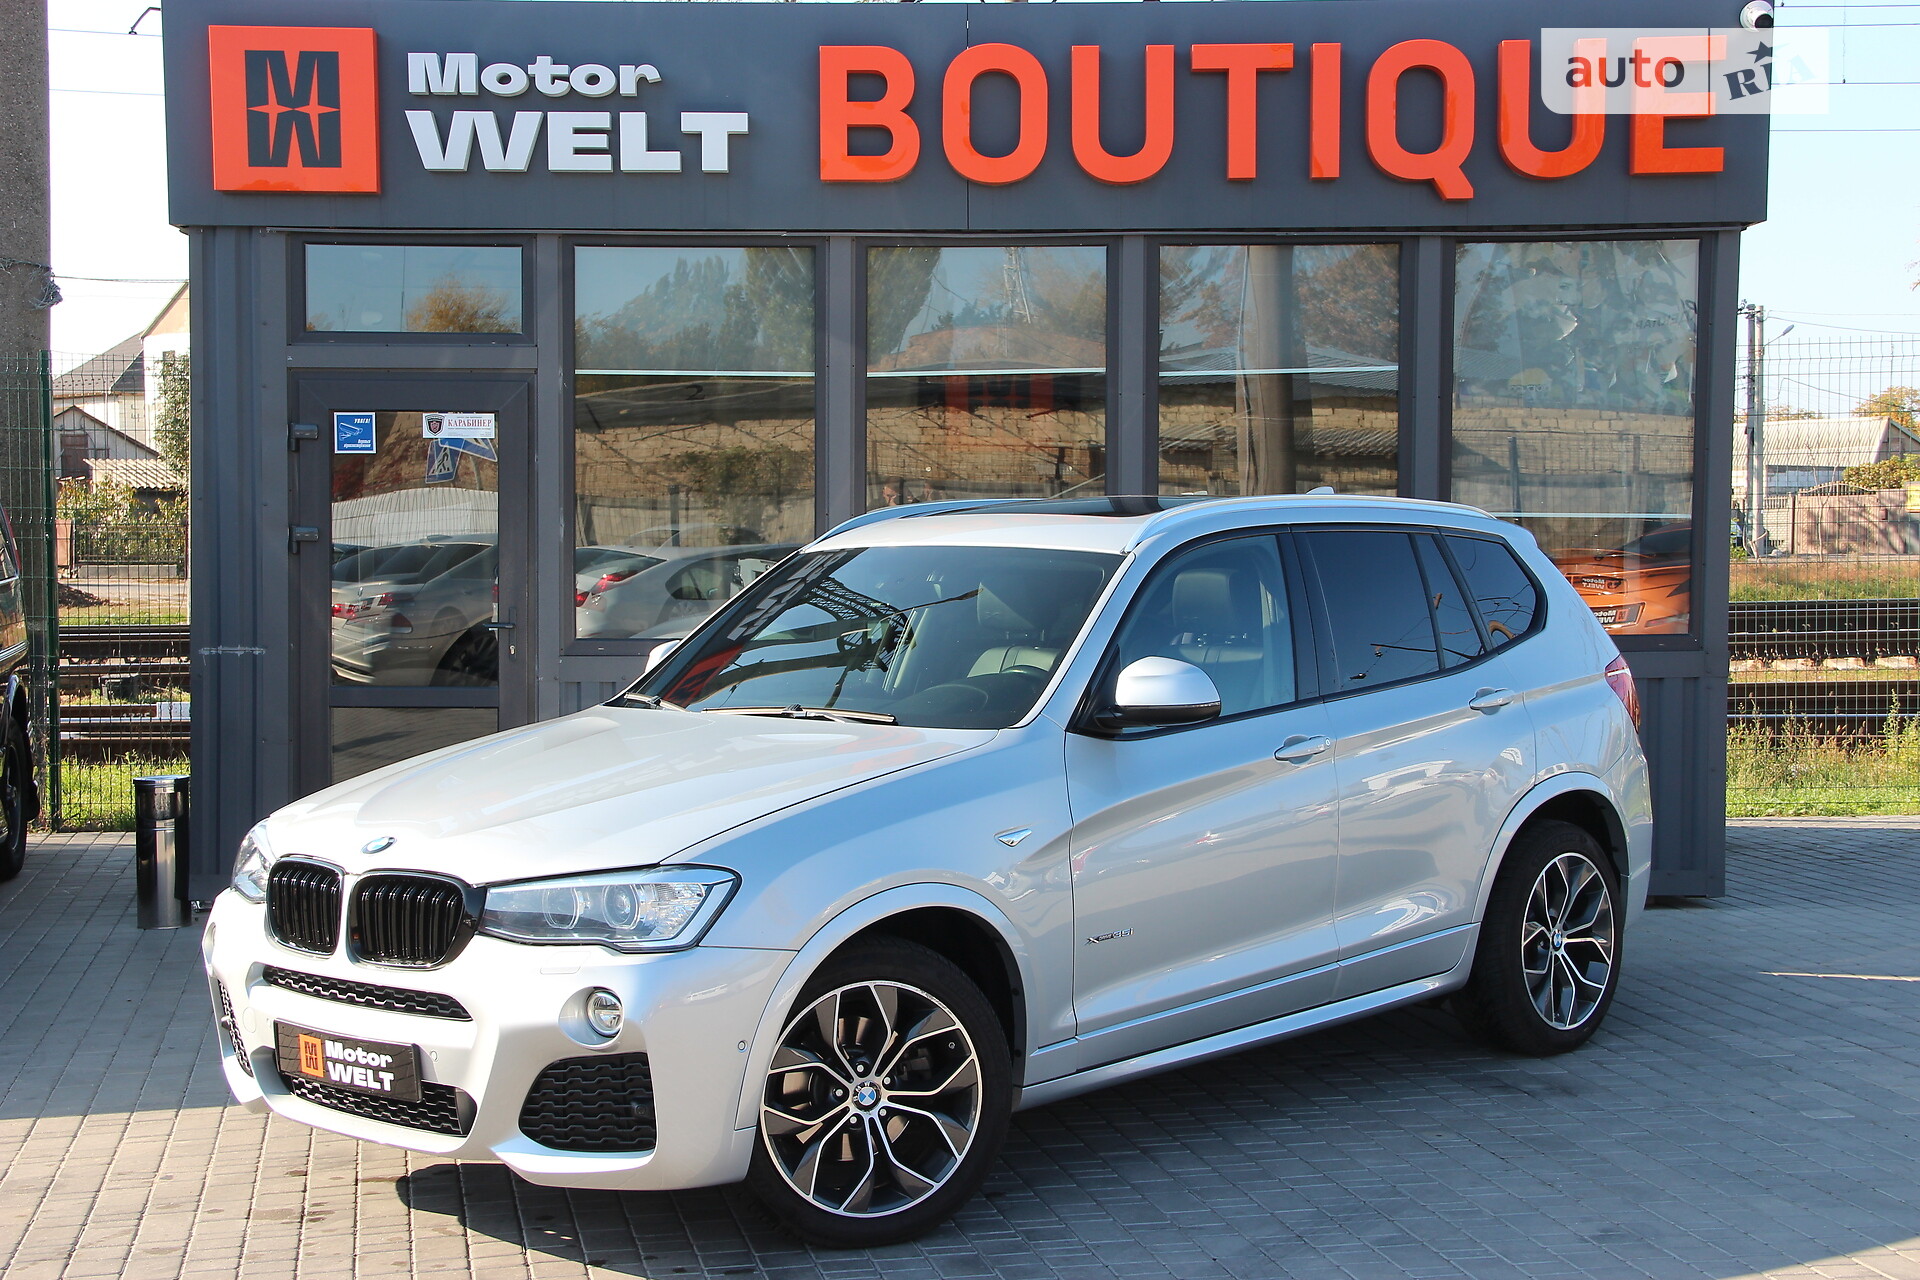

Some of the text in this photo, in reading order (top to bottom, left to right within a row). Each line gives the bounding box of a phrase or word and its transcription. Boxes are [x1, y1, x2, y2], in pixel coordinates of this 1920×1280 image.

[407, 51, 662, 97] Motor
[819, 35, 1728, 201] BOUTIQUE
[404, 110, 749, 173] WELT
[447, 419, 492, 427] КАРАБИНЕР
[325, 1040, 393, 1068] Motor
[327, 1061, 394, 1091] WELT
